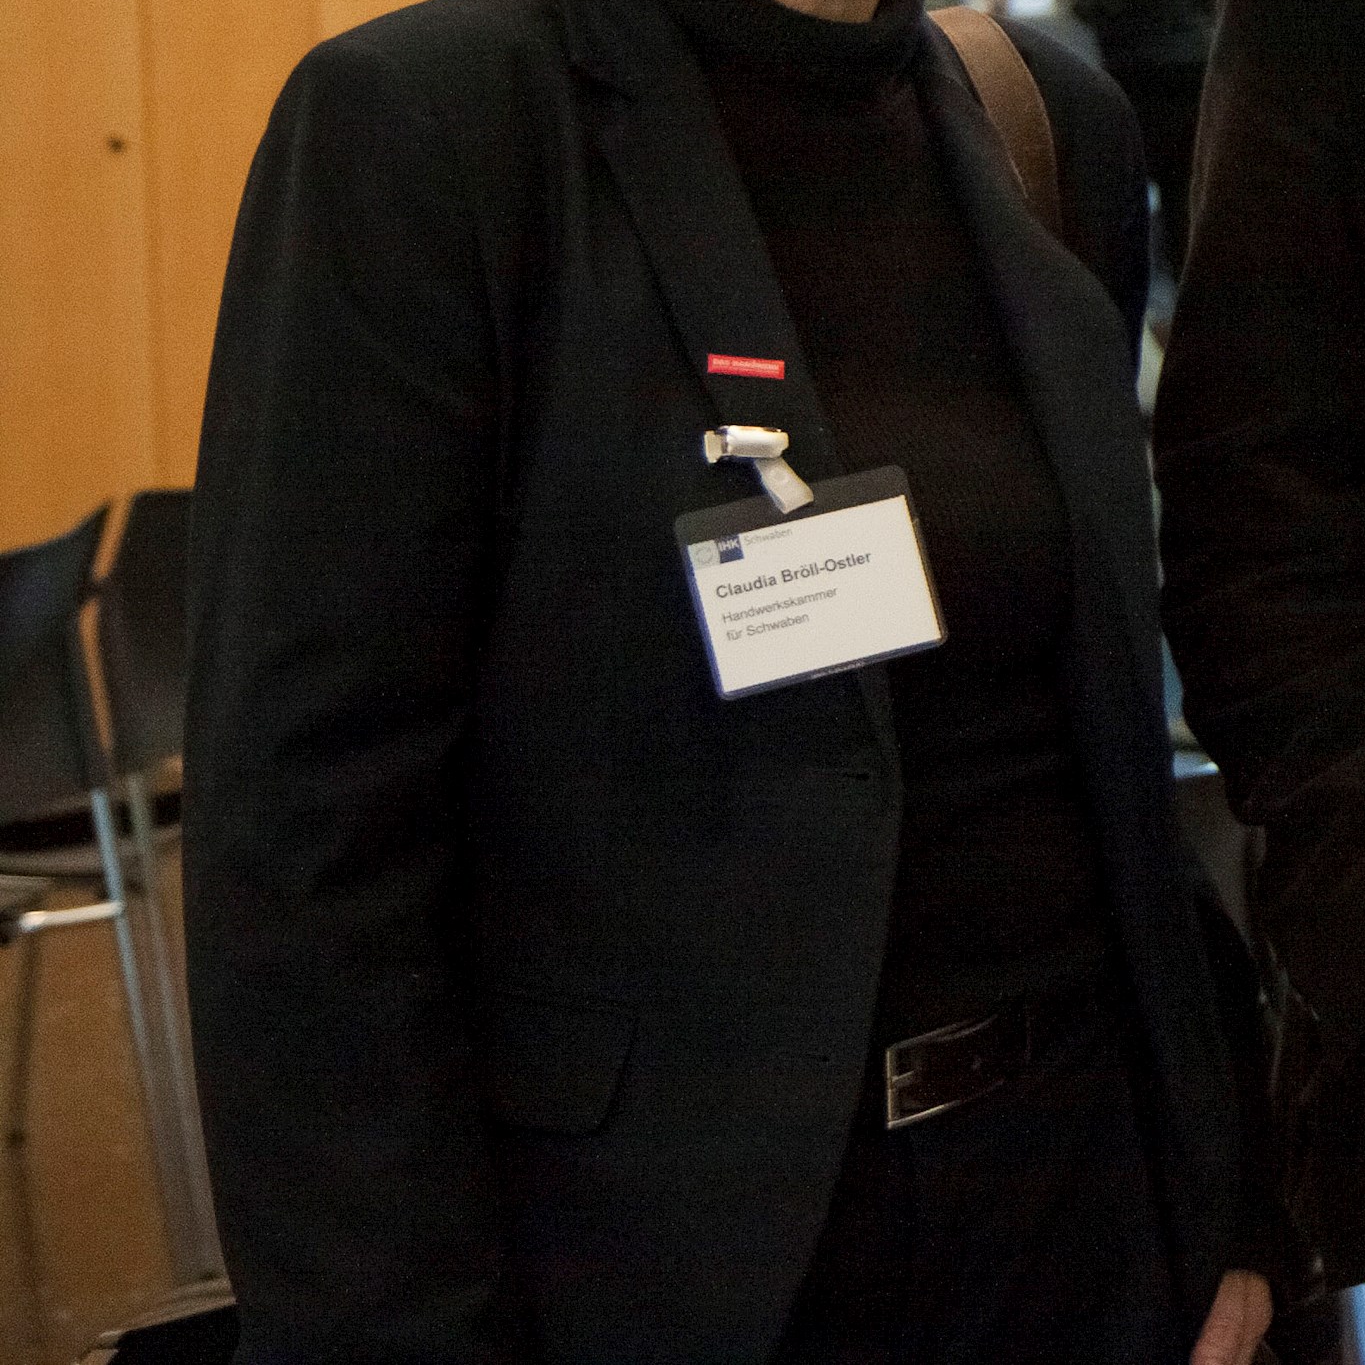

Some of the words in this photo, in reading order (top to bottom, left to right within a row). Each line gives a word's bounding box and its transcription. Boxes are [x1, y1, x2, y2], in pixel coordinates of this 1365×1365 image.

[718, 538, 741, 551] IHK
[743, 527, 793, 546] Schwaben
[716, 575, 777, 599] Claudia
[781, 552, 872, 583] Bröll-Ostler
[722, 587, 837, 624] Handwerkskammer
[727, 629, 744, 641] für
[746, 613, 810, 636] Schwaben
